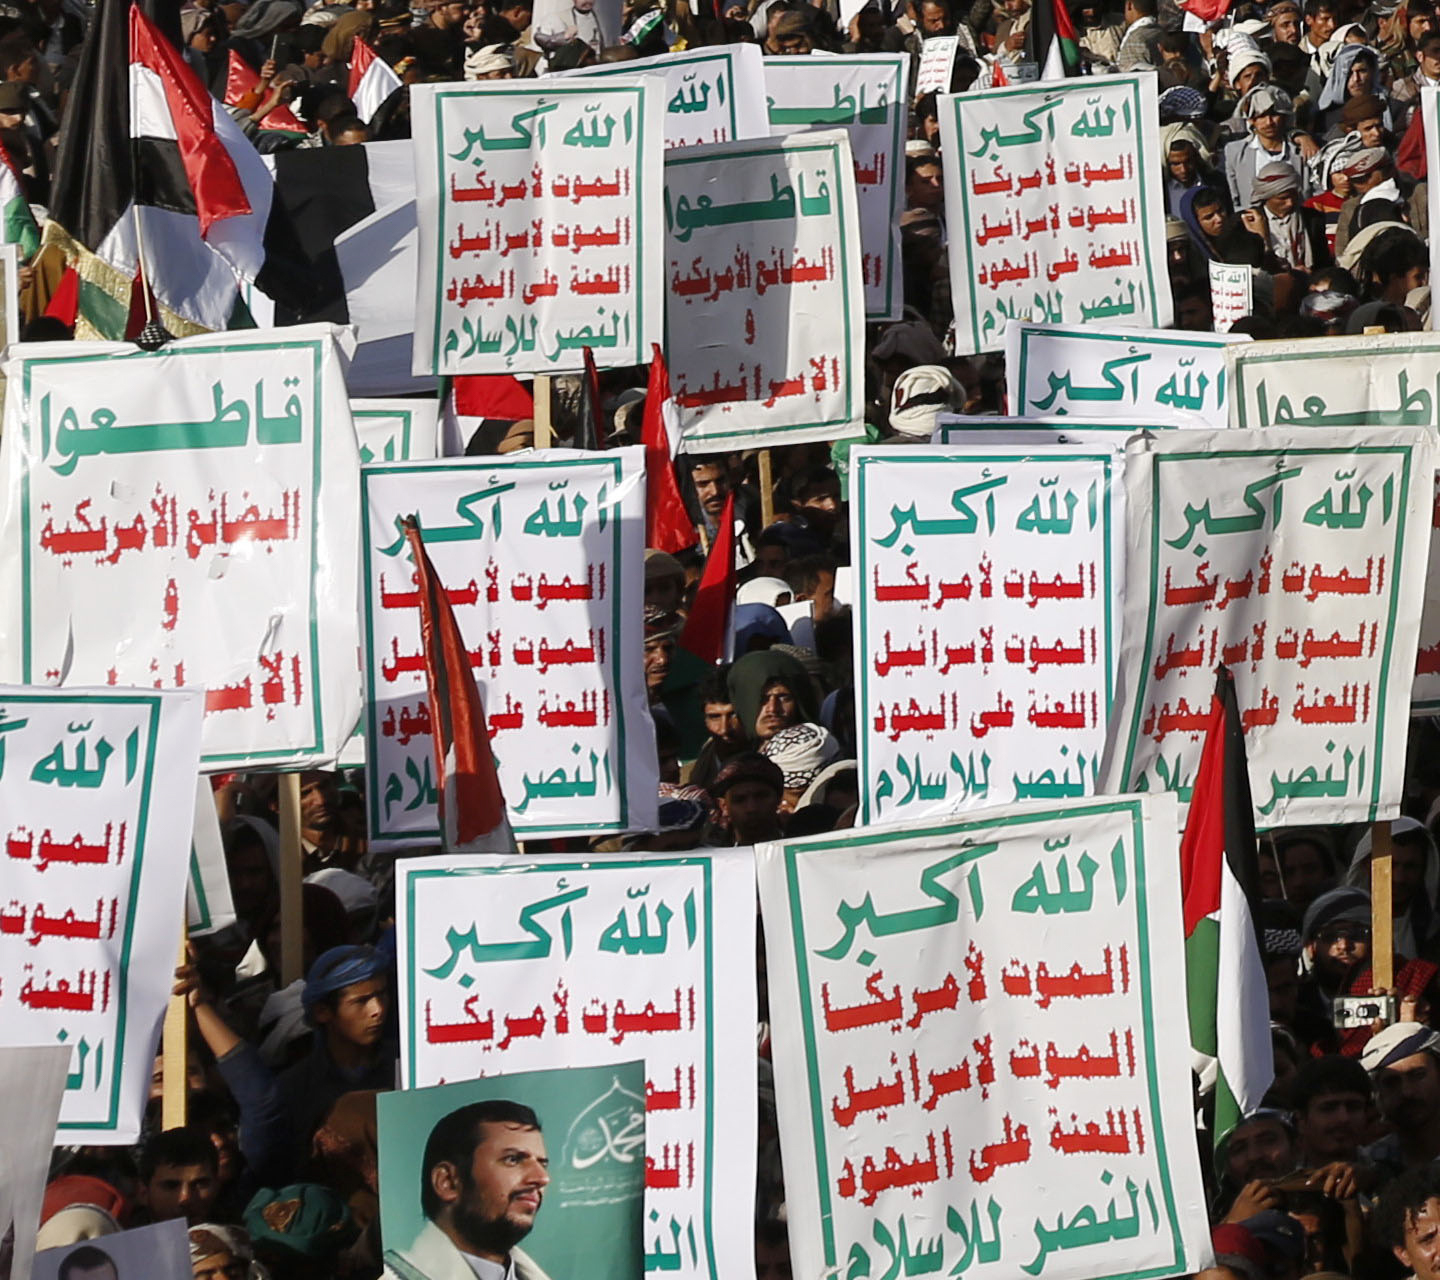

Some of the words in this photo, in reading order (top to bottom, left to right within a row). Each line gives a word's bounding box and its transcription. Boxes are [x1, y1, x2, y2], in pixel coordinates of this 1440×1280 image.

[664, 168, 831, 243] قاطعوا
[756, 243, 835, 296] البضائع
[744, 307, 755, 345] و
[872, 470, 1011, 559] أكبر
[1014, 477, 1100, 537] الله
[871, 559, 995, 612] لأمريكا
[1001, 562, 1099, 611] الموت
[1002, 627, 1099, 675] الموت
[871, 692, 961, 745] اليهود
[968, 690, 1018, 742] على
[1025, 687, 1100, 731] اللعنة
[1011, 743, 1101, 803] النصر
